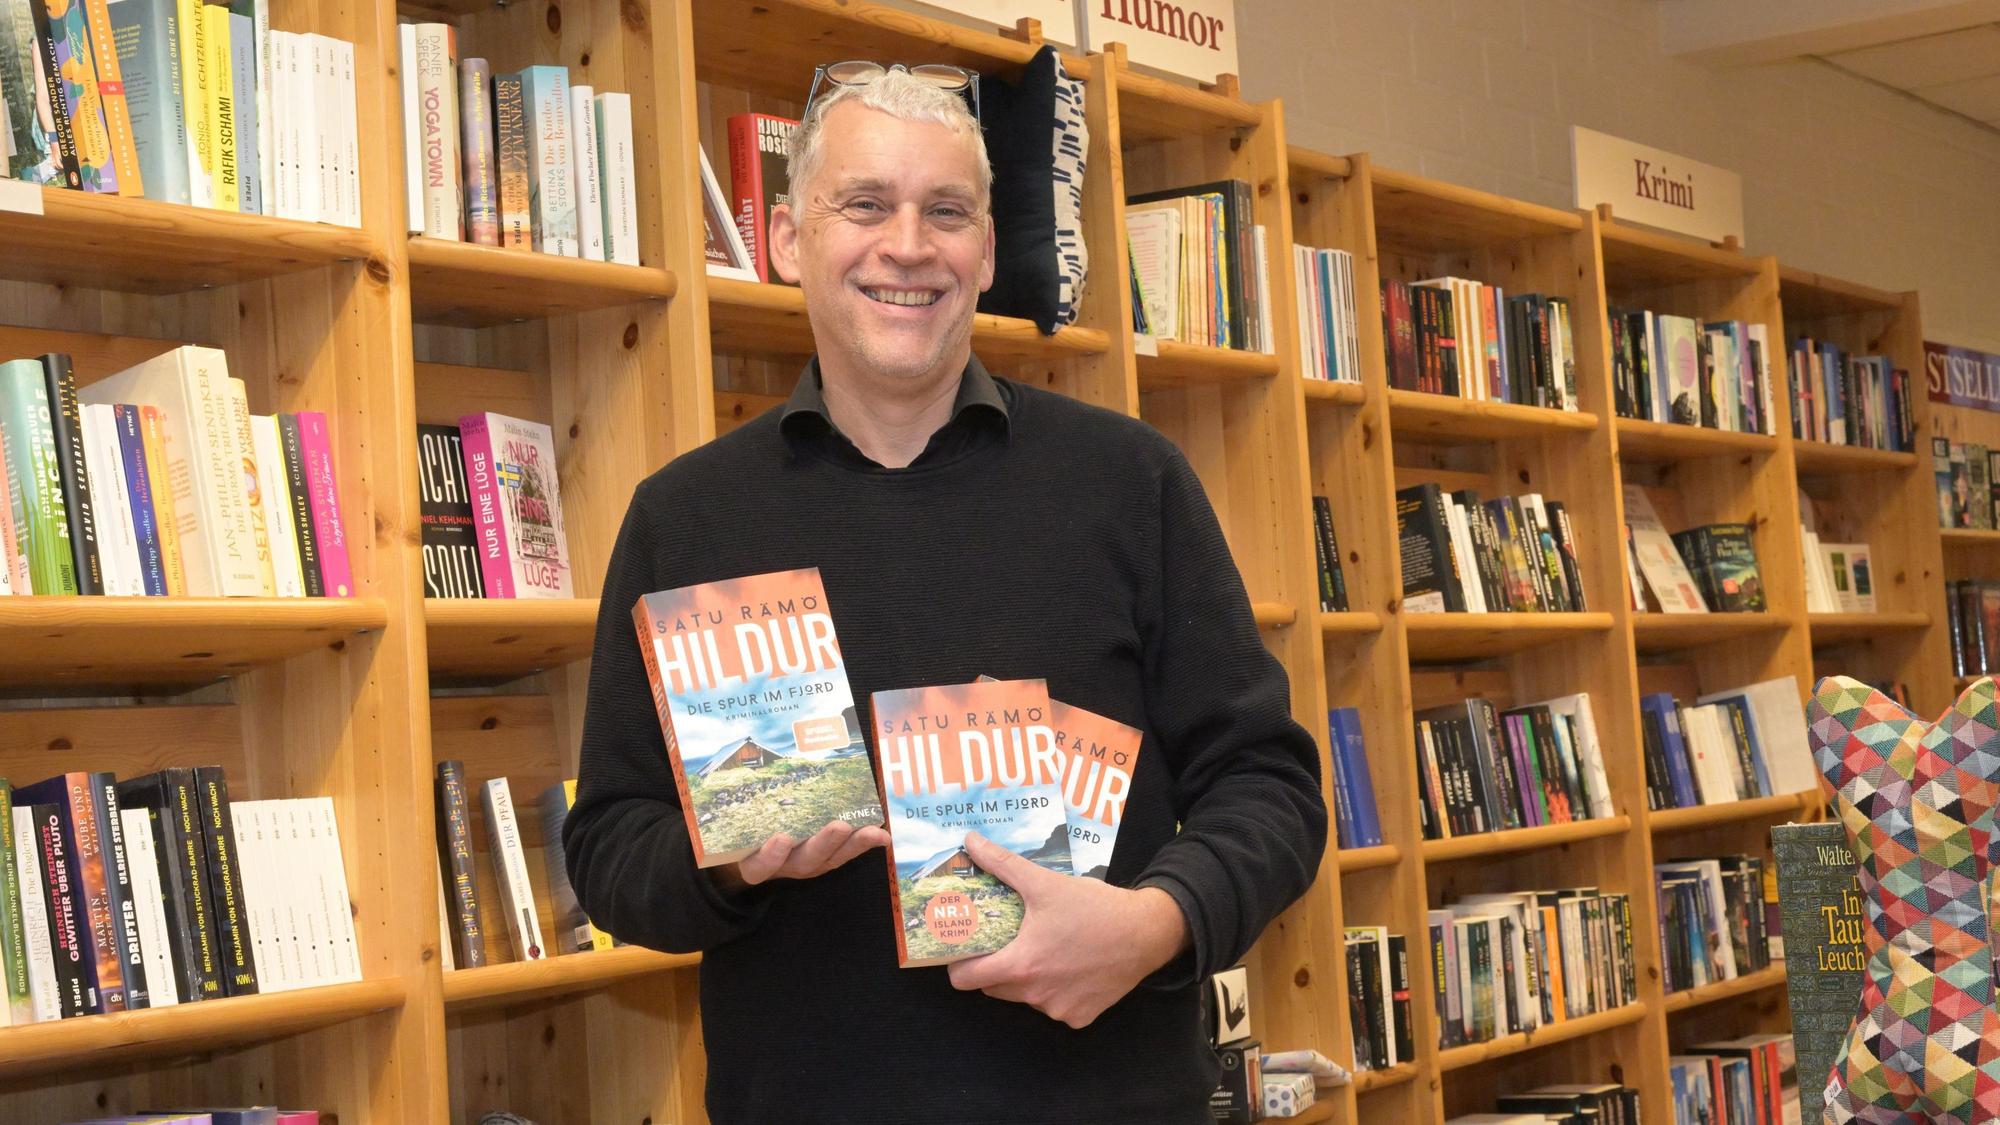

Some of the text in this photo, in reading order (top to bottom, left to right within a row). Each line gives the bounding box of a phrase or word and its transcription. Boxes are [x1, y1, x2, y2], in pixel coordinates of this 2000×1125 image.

[167, 16, 181, 95] DIE TAGE OHNE DICH
[416, 38, 430, 76] SPECK
[429, 35, 442, 78] DANIEL
[47, 37, 77, 156] ALLES RICHTIG GEMACHT
[47, 76, 69, 157] GREGOR SANDER
[218, 96, 234, 146] SCHAMI
[551, 73, 567, 165] von Beauvallon
[197, 120, 206, 155] TONIO
[424, 86, 444, 188] YOGA TOWN
[497, 80, 514, 165] VON HIER BIS
[508, 80, 527, 164] ZUM ANFANG
[541, 99, 555, 165] Die Kinder
[757, 117, 800, 139] HJORT
[220, 149, 235, 185] RAFIK
[583, 99, 597, 204] Elena Fischer Paradise Garden
[245, 175, 253, 202] PIPER
[507, 177, 515, 204] CHRIS
[546, 168, 558, 212] BETTINA
[557, 168, 567, 207] STORKS
[1634, 159, 1695, 211] Krimi
[513, 220, 522, 245] PIPER
[58, 380, 71, 416] BITTE
[198, 367, 219, 449] SENDKER
[126, 414, 135, 436] HEYNE
[231, 396, 247, 454] VOR DER
[461, 419, 485, 430] Malin
[464, 427, 487, 438] Stehn
[504, 423, 540, 440] Malin Stehn
[27, 404, 53, 520] JOHANNA SEBAUER
[215, 393, 246, 534] DIE BURMA TRILOGIE
[311, 448, 325, 505] SHIPMAN
[417, 434, 468, 504] ICHT
[507, 440, 540, 468] NUR
[72, 436, 94, 541] DAVID SEDARIS
[286, 425, 314, 562] ZERUYA SHALEV SCHICKSAL
[473, 452, 500, 559] NUR EINE LÜGE
[142, 509, 163, 597] Jan-Philipp Sendker
[250, 509, 270, 562] SETZ
[319, 511, 332, 548] VIOLA
[60, 564, 73, 591] DUMONT
[90, 554, 99, 584] BLESSING
[309, 569, 319, 595] PIPER
[523, 559, 560, 590] LÜGE
[655, 595, 818, 635] SATU RÄMÖ
[652, 612, 842, 696] HILDUR
[653, 681, 678, 753] HILDUR
[687, 681, 834, 716] DIE SPUR IM FJORD
[725, 703, 800, 722] KRIMINALROMAN
[883, 706, 1043, 734] SATU RÄMÖ
[878, 724, 1061, 798] HILDUR
[1055, 730, 1130, 766] RÄMÖ
[73, 785, 93, 858] TAUBE UND
[83, 791, 100, 854] WILDENTE
[496, 790, 516, 849] DER PFAU
[838, 807, 871, 821] HEYNE
[905, 796, 1050, 819] DIE SPUR IM FJORD
[941, 816, 1015, 828] KRIMINALROMAN
[21, 831, 37, 895] Die Büglerin
[41, 825, 68, 949] HEINRICH STEINFEST
[48, 814, 80, 962] GEWITTER ÜBER PLUTO
[104, 785, 142, 965] DRIFTER ULRIKE STERBLICH
[178, 785, 212, 973] BENJAMIN VON STUCKRAD-BARRE NOCH WACH?
[208, 781, 244, 967] BENJAMIN VON STUCKRAD-BARRE NOCH WACH?
[3, 818, 26, 994] STAMM IN EINER DUNKELBLAUEN STUNDE
[90, 897, 108, 949] MARTIN
[99, 887, 117, 956] MOSEBACH
[934, 918, 973, 930] ISLAND
[940, 895, 961, 905] DER
[939, 928, 970, 939] KRIMI
[1821, 905, 1866, 946] Tau
[1817, 945, 1866, 972] Leuch
[71, 977, 82, 1008] PIPER
[110, 993, 123, 1003] dtv
